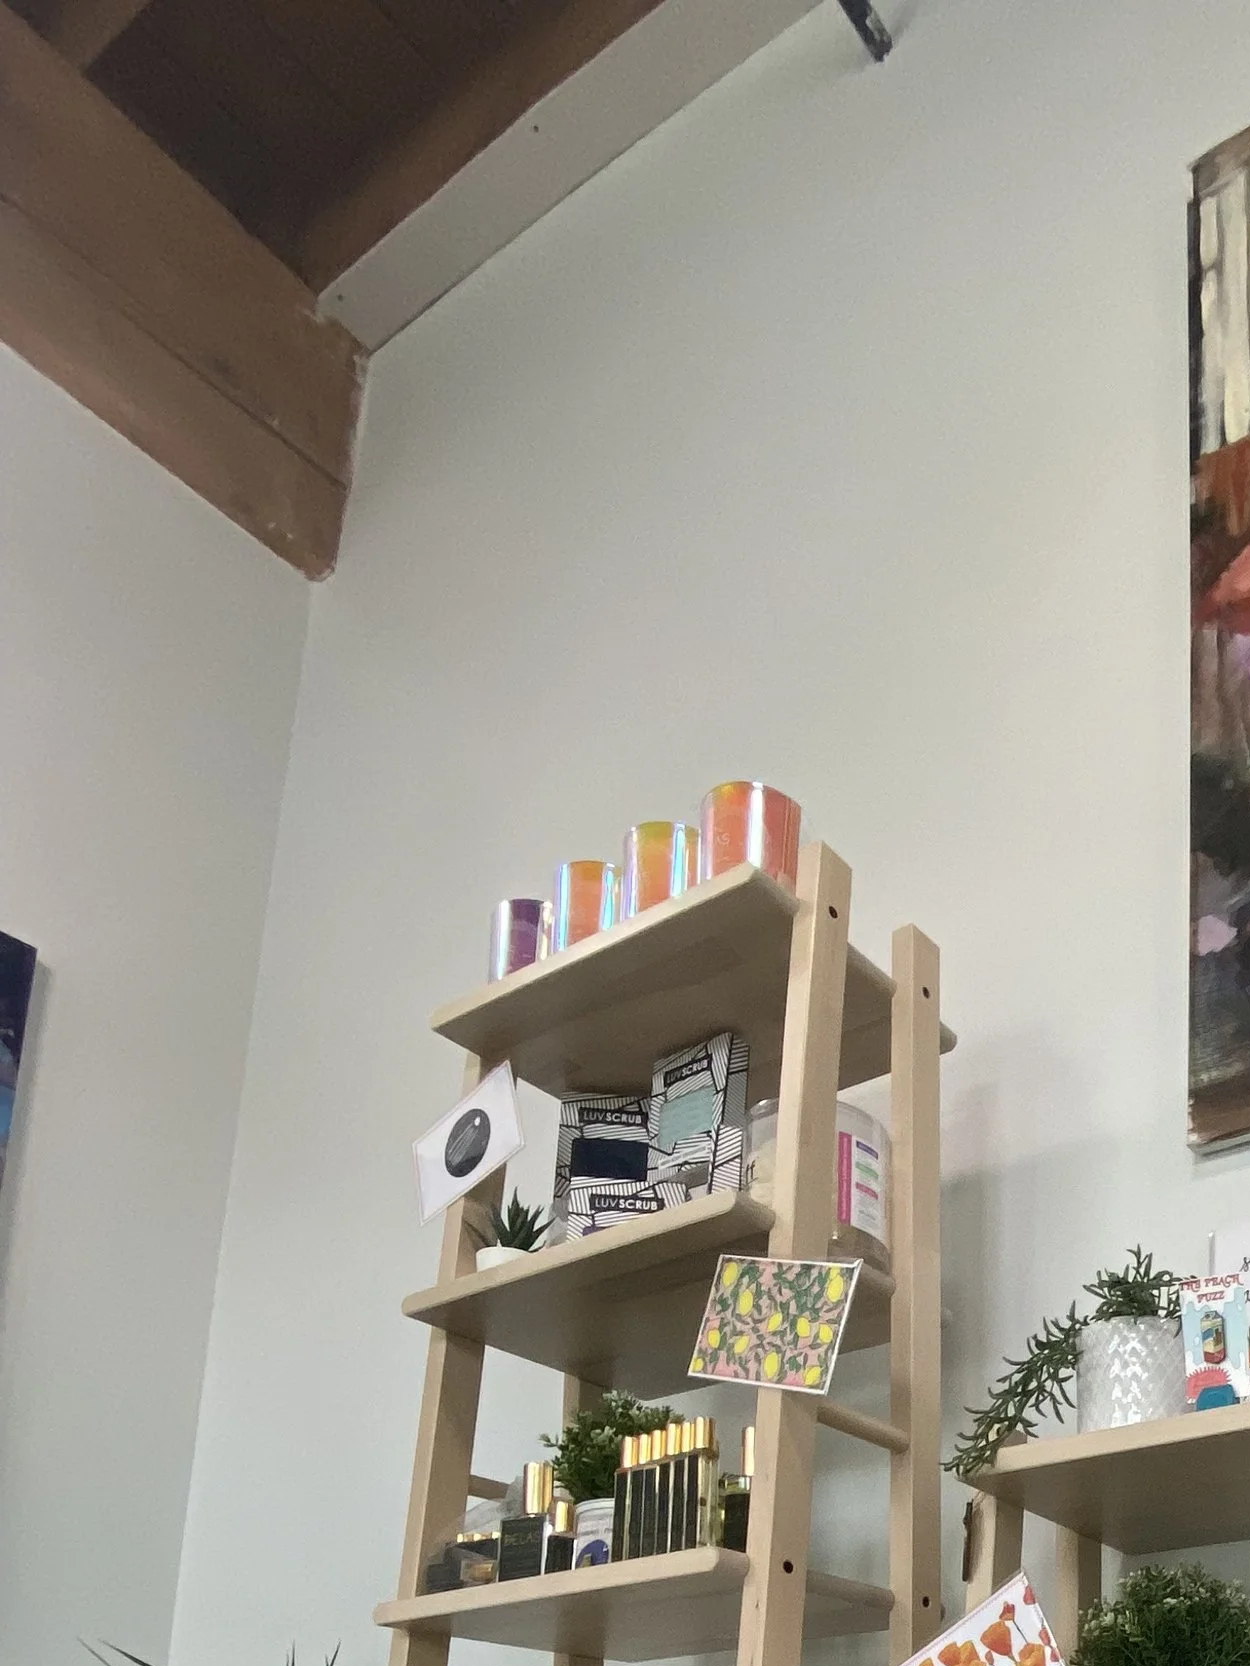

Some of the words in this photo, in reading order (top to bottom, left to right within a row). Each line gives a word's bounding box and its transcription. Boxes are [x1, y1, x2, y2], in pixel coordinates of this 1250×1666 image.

[666, 1059, 708, 1083] LUVSCRUB
[583, 1110, 642, 1124] LUVSCRUB
[595, 1197, 658, 1211] LUVSCRUB
[1204, 1273, 1244, 1288] PEACH
